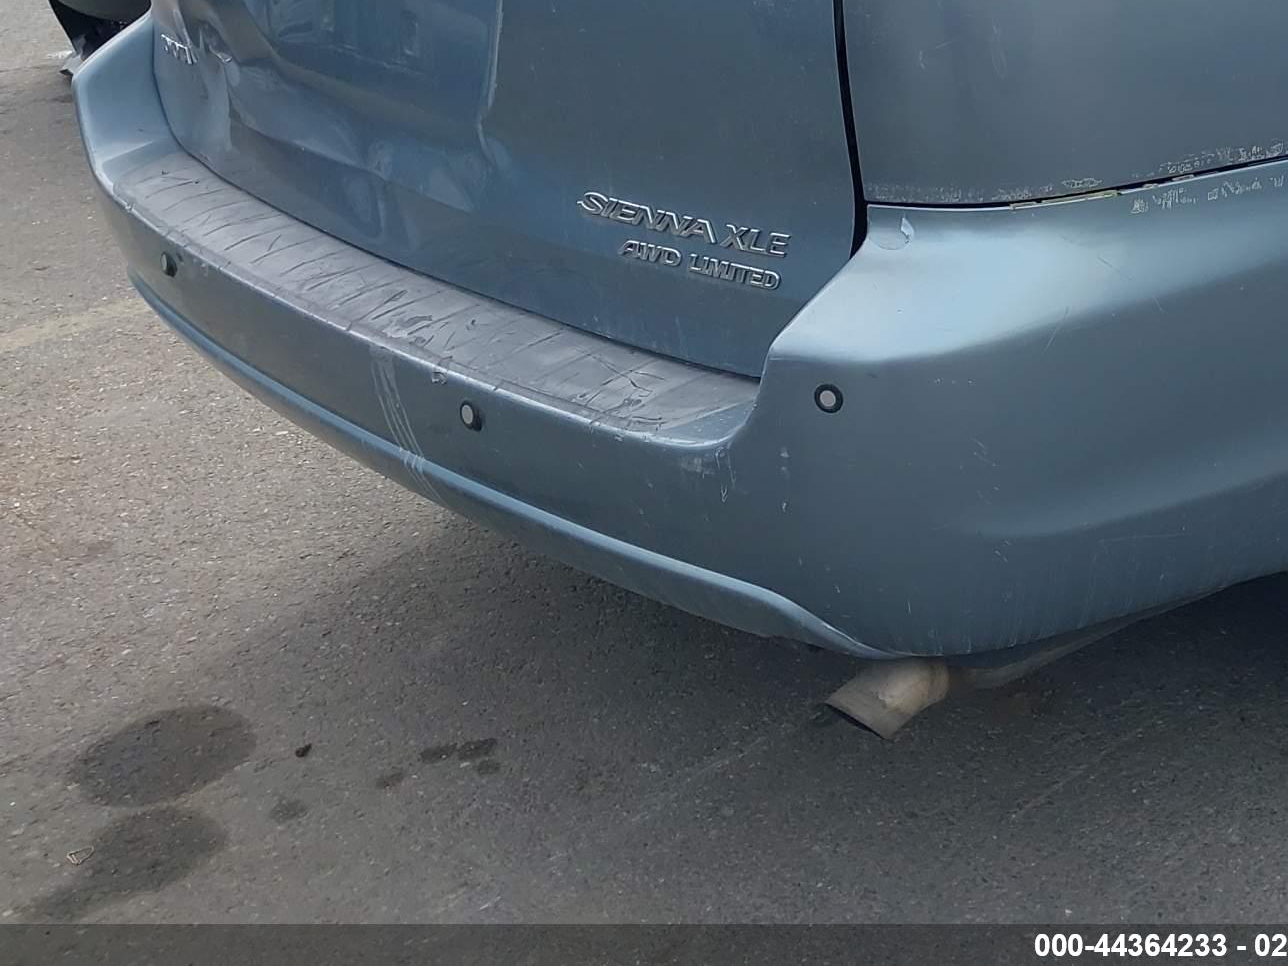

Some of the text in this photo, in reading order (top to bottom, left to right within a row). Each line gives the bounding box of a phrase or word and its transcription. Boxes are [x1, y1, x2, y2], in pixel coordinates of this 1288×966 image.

[577, 191, 791, 258] SIENNA XLE
[618, 239, 782, 290] AWD LIMITED
